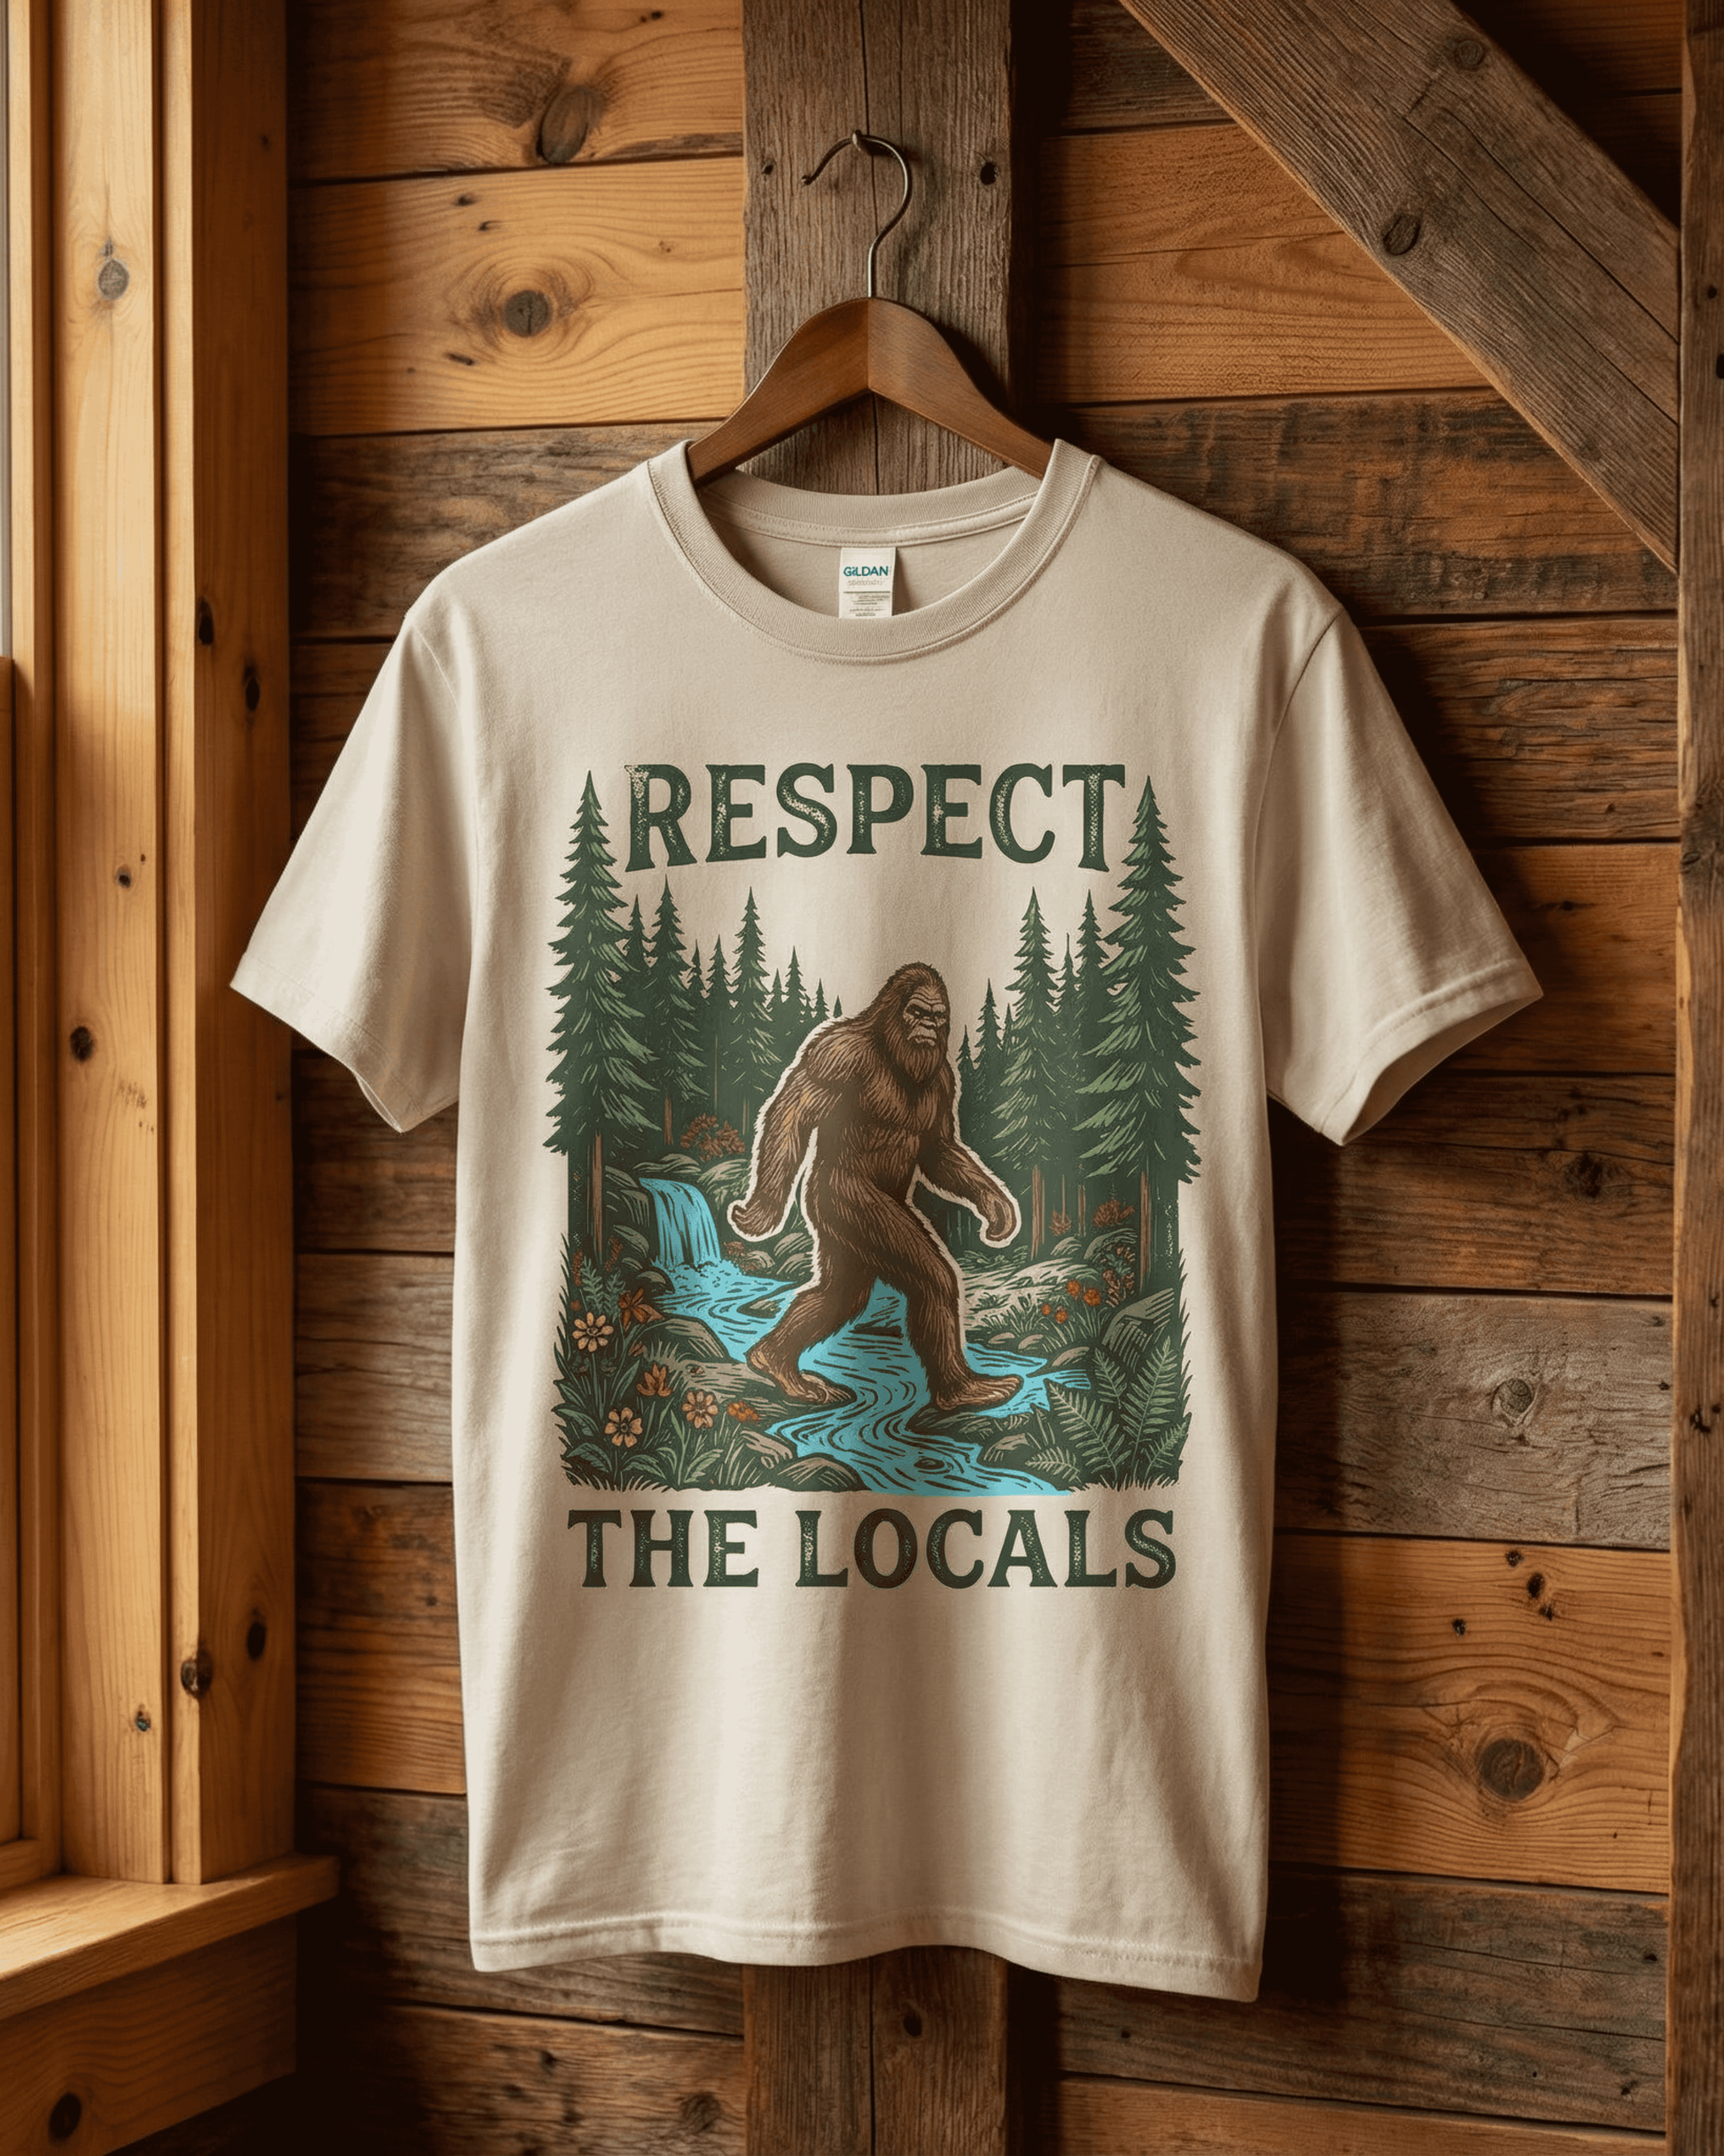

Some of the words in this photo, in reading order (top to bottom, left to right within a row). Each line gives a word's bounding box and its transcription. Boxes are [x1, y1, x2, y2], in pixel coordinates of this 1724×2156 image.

[624, 762, 1126, 873] RESPECT
[566, 1508, 759, 1589] THE
[795, 1507, 1177, 1590] LOCALS
